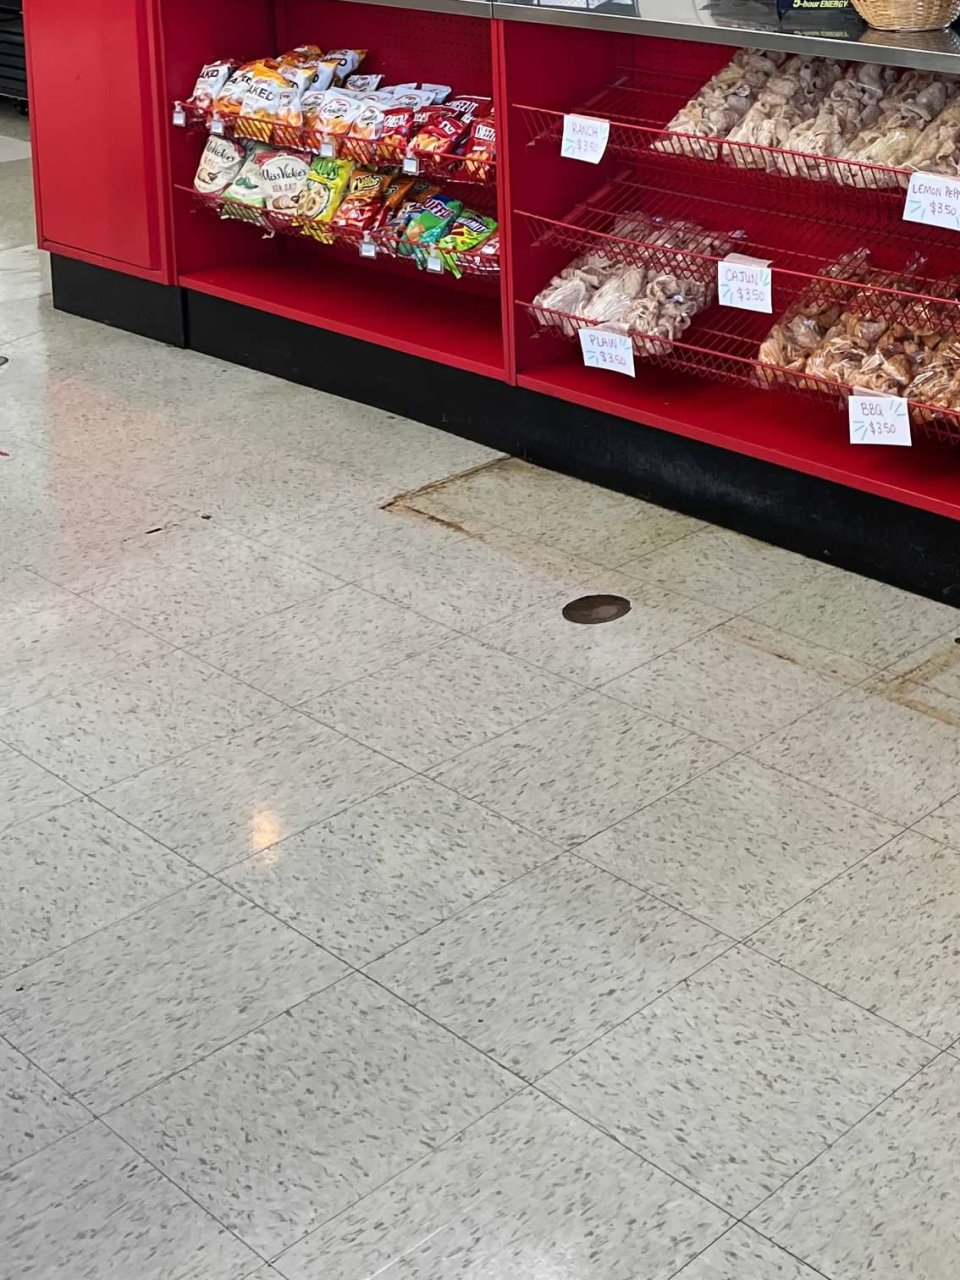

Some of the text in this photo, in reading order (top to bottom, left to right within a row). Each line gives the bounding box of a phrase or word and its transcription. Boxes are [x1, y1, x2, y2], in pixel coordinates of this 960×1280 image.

[820, 0, 849, 8] ENERGY
[572, 122, 598, 137] RANCH
[912, 183, 942, 197] LEMON
[725, 268, 759, 285] CAJUN
[589, 334, 618, 349] PLAIN
[860, 402, 885, 417] BBQ
